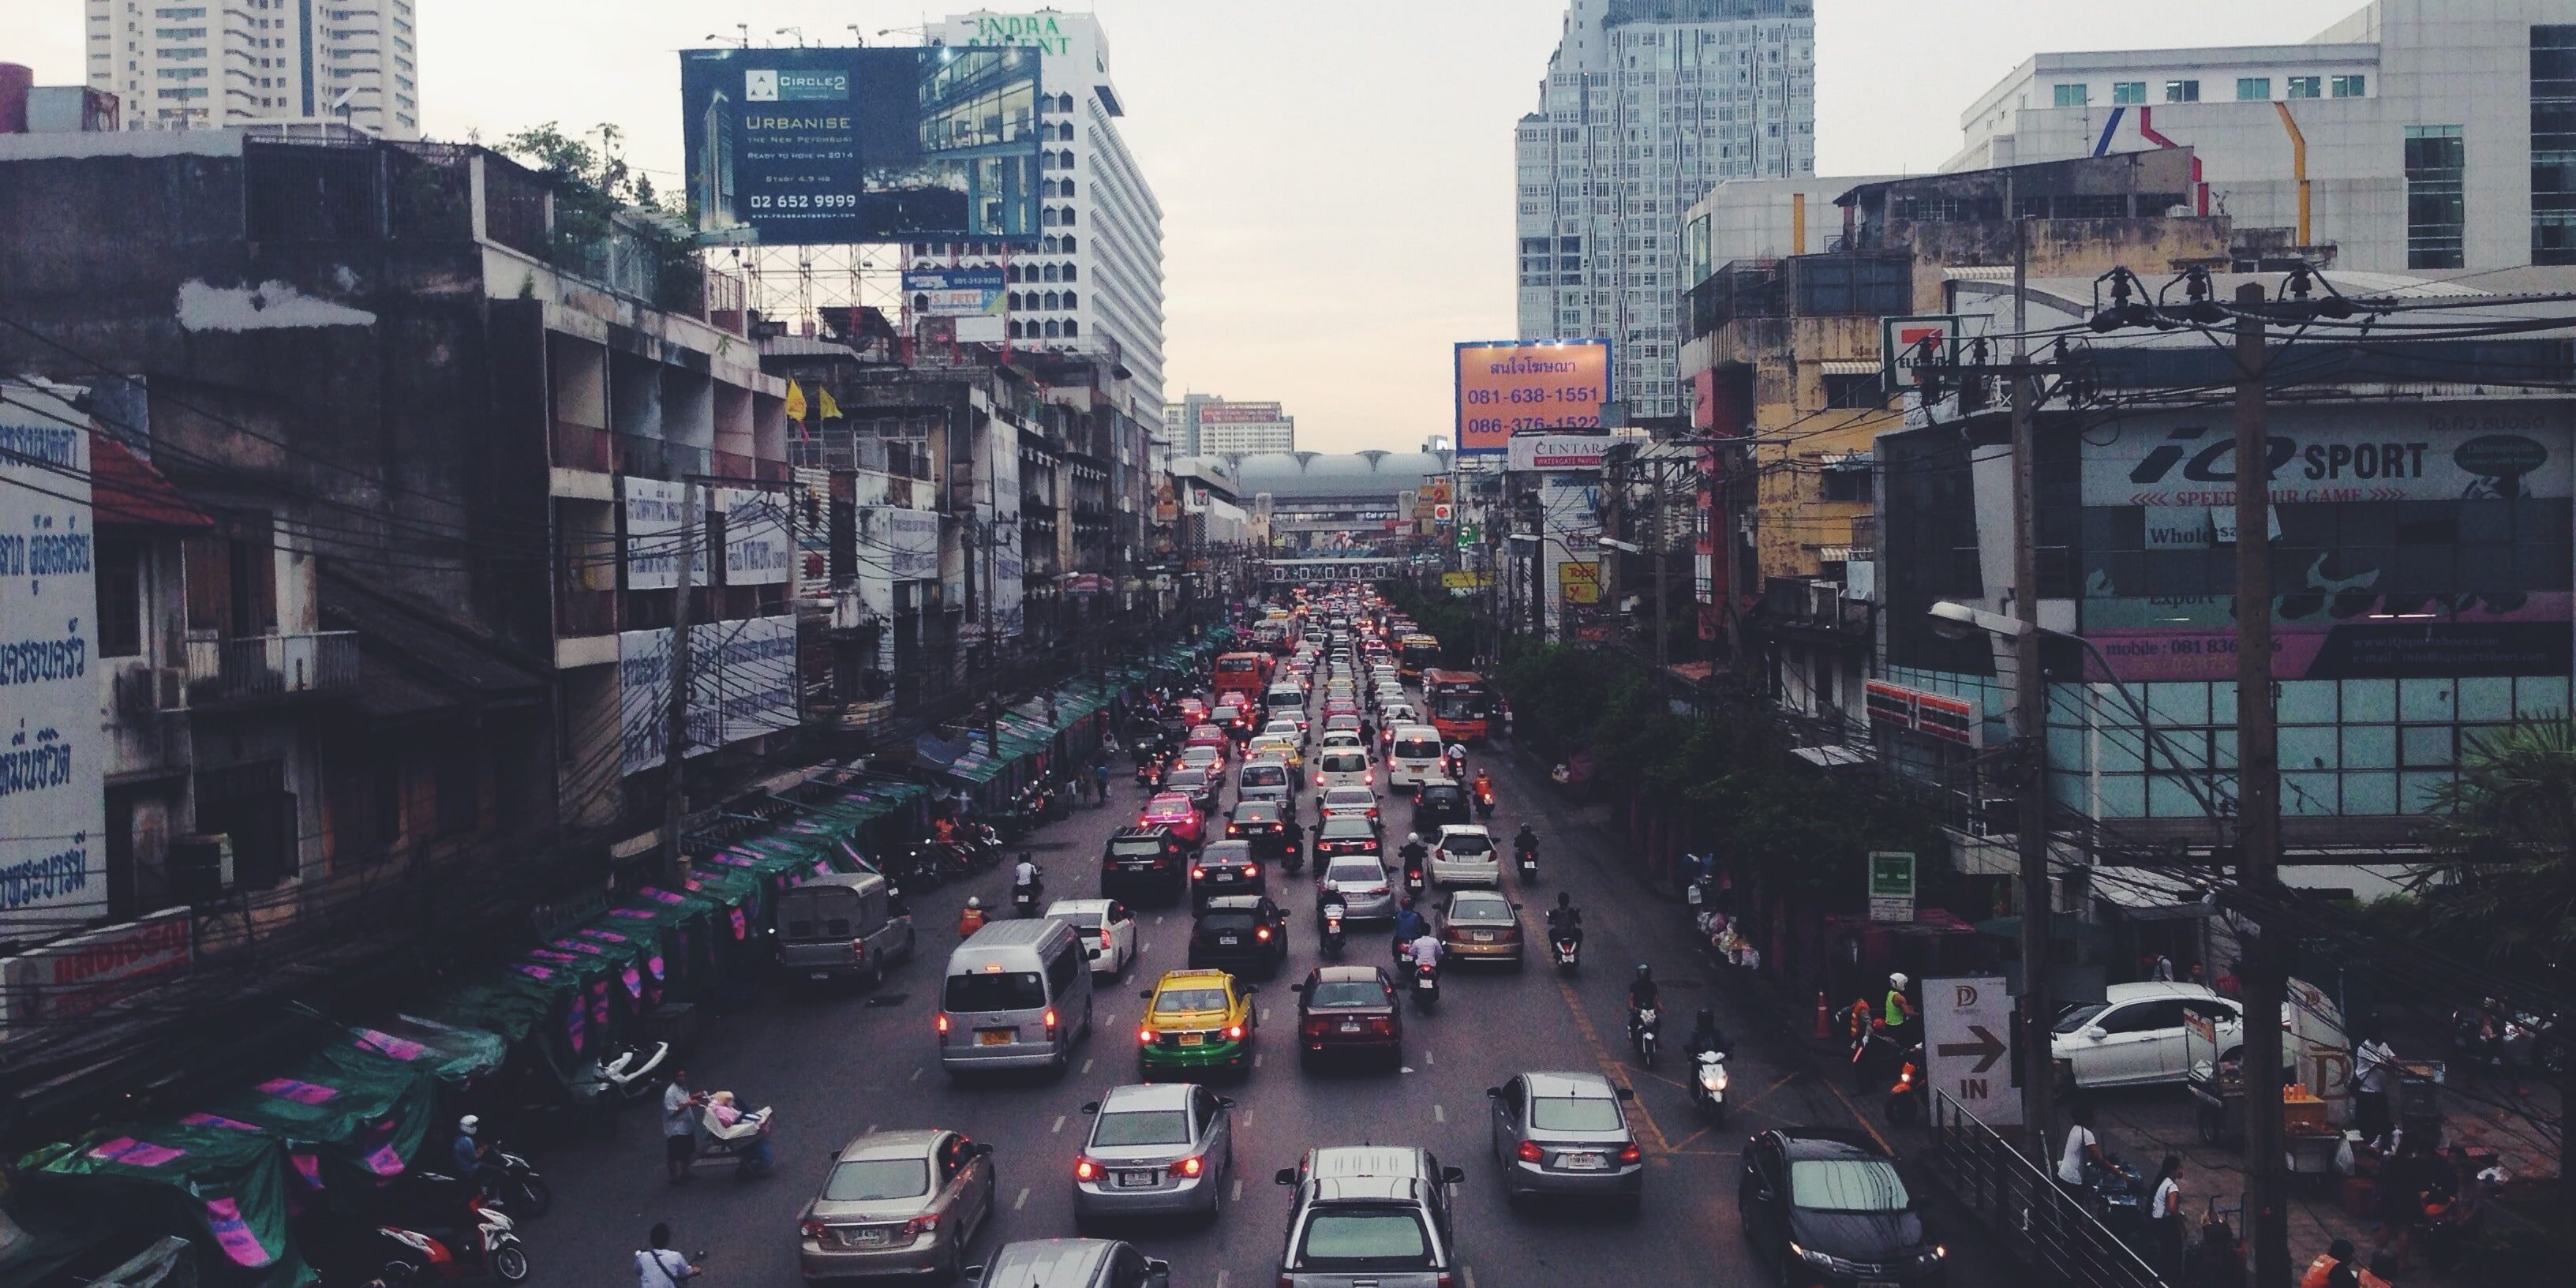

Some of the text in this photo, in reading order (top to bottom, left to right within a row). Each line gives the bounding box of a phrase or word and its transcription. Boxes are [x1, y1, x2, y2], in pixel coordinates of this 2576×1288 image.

[978, 16, 1059, 36] INDRA
[751, 194, 856, 208] 02 652 9999
[1490, 356, 1576, 375] สนใจโฆษณา
[1467, 387, 1598, 405] 081-638-1551
[1467, 416, 1601, 434] 086-376-1522
[2304, 442, 2429, 481] SPORT
[2176, 490, 2237, 507] SPEED
[2305, 487, 2363, 503] GAME
[0, 616, 86, 686] ครอบครัว
[2106, 639, 2159, 656] mobile
[2172, 639, 2201, 654] 081
[2207, 638, 2238, 653] 836
[1960, 1078, 1988, 1099] IN
